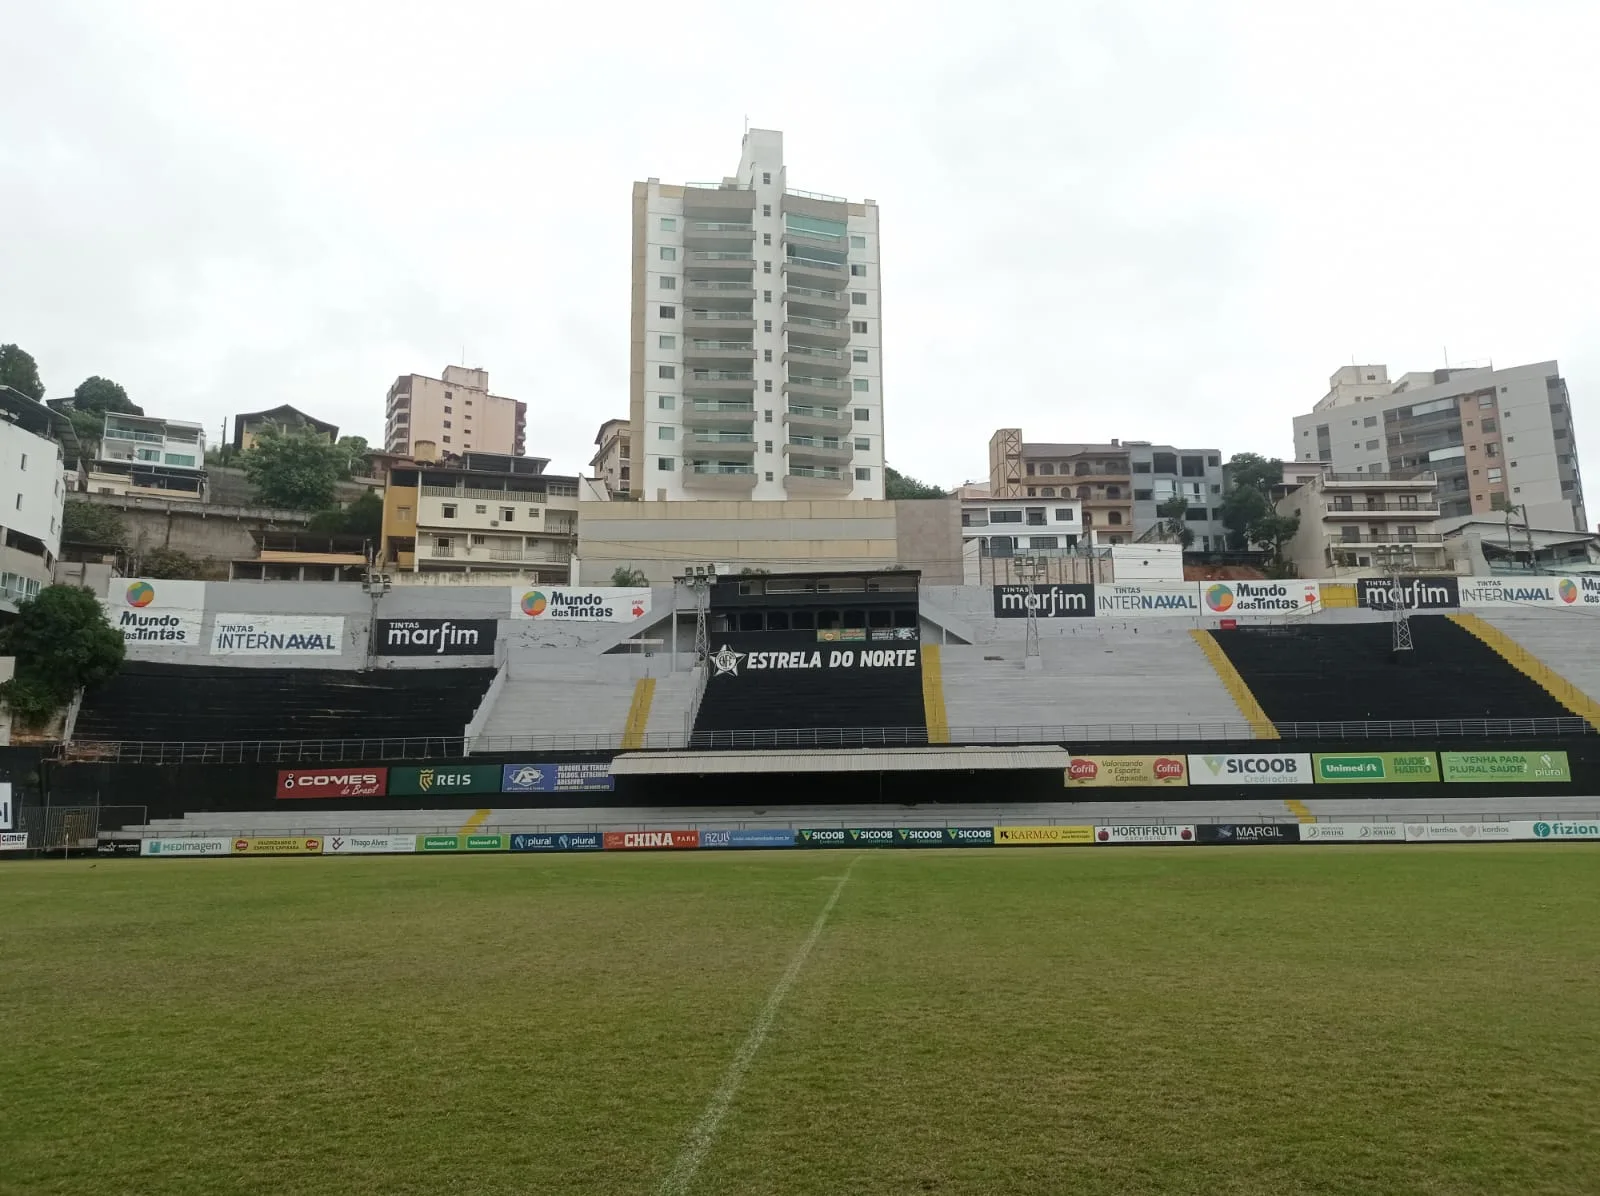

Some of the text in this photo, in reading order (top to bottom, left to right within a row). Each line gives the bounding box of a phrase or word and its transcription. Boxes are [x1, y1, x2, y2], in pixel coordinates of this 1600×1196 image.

[1236, 582, 1287, 597] Mundo
[1366, 580, 1448, 609] marfim
[1462, 588, 1554, 601] INTERNAVAL
[551, 591, 603, 606] Mundo
[1001, 587, 1086, 617] marfim
[1099, 595, 1197, 610] INTERNAVAL
[120, 611, 180, 627] Mundo
[217, 633, 336, 650] INTERNAVAL
[388, 622, 479, 653] marfim
[747, 652, 822, 669] ESTRELA
[829, 651, 854, 668] DO
[860, 649, 917, 667] NORTE
[1462, 756, 1497, 764] VENHA
[1071, 764, 1095, 774] Cofril
[1156, 764, 1180, 773] Cofril
[1226, 758, 1297, 774] SICOOB
[1326, 763, 1363, 772] Unimed
[1449, 765, 1488, 773] PLURAL
[1535, 768, 1563, 777] plural
[437, 774, 471, 785] REIS
[1112, 826, 1177, 836] HORTIFRUTI
[1236, 826, 1283, 837] MARGIL
[1552, 822, 1599, 834] fizion
[624, 832, 674, 847] CHINA
[704, 833, 728, 842] AZUL
[812, 831, 845, 840] SICOOB
[860, 831, 893, 839] SICOOB
[909, 831, 942, 839] SICOOB
[958, 830, 992, 839] SICOOB
[351, 839, 371, 847] Thiago
[372, 838, 388, 846] Alves
[528, 837, 551, 847] plural
[571, 836, 596, 846] plural
